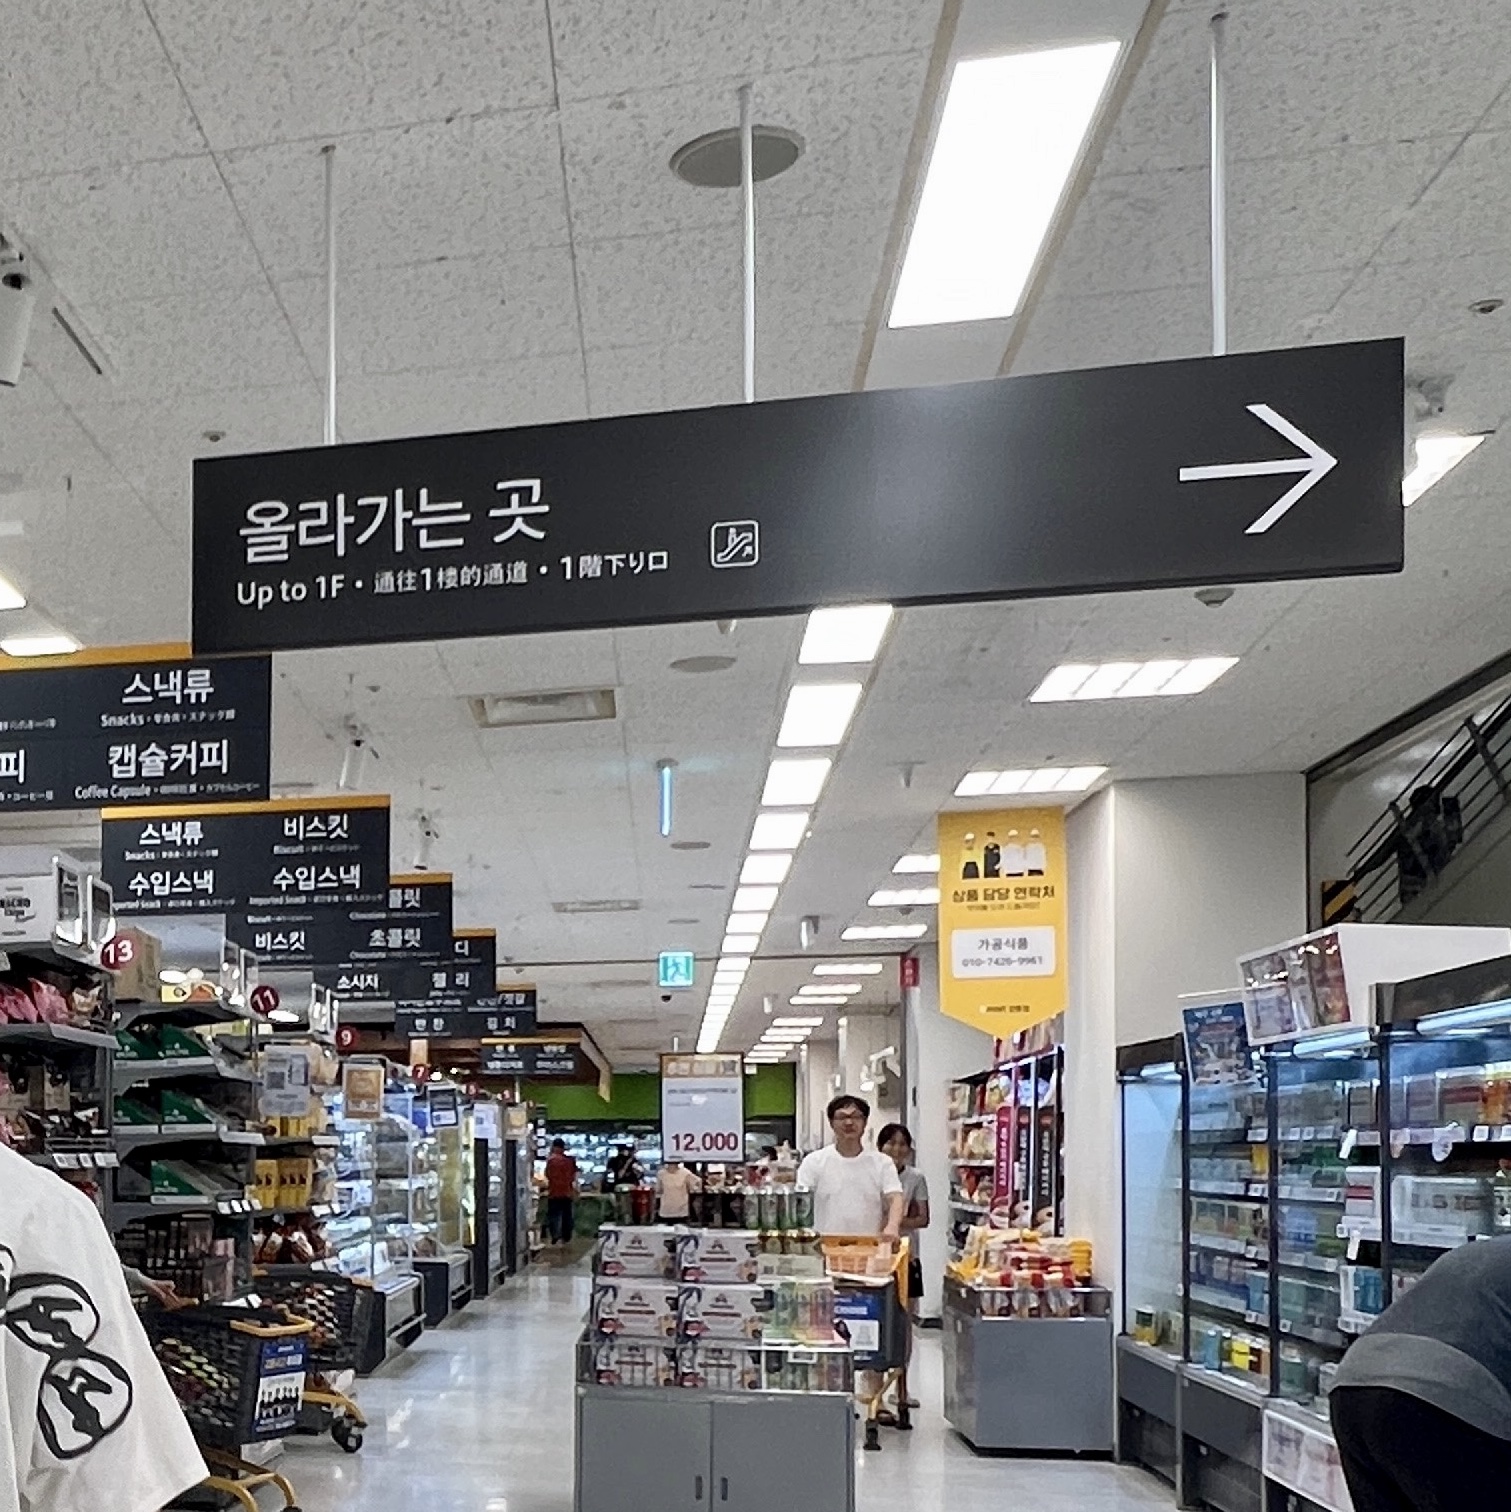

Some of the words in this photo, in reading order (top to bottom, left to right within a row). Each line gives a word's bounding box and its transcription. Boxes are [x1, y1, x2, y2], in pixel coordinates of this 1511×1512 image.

[238, 486, 472, 564] 올라가는
[487, 477, 551, 545] 곳
[236, 581, 274, 611] Up
[281, 578, 307, 602] to
[316, 574, 345, 600] 1F
[121, 668, 215, 706] 스낵류
[100, 712, 146, 728] Snacks
[107, 738, 229, 780] 캡슐커피
[74, 784, 109, 800] Coffee
[110, 784, 152, 801] Capsule
[138, 820, 205, 847] 스낵류
[283, 812, 349, 841] 비스킷
[128, 868, 214, 897] 수입스낵
[272, 863, 361, 892] 수입스낵
[1013, 885, 1055, 900] 연락처
[254, 929, 306, 951] 비스킷
[369, 927, 421, 949] 초콜릿
[976, 937, 1029, 951] 가공식품
[103, 939, 134, 964] 13
[336, 972, 379, 990] 소시지
[254, 992, 277, 1013] 11
[671, 1131, 739, 1153] 12,000
